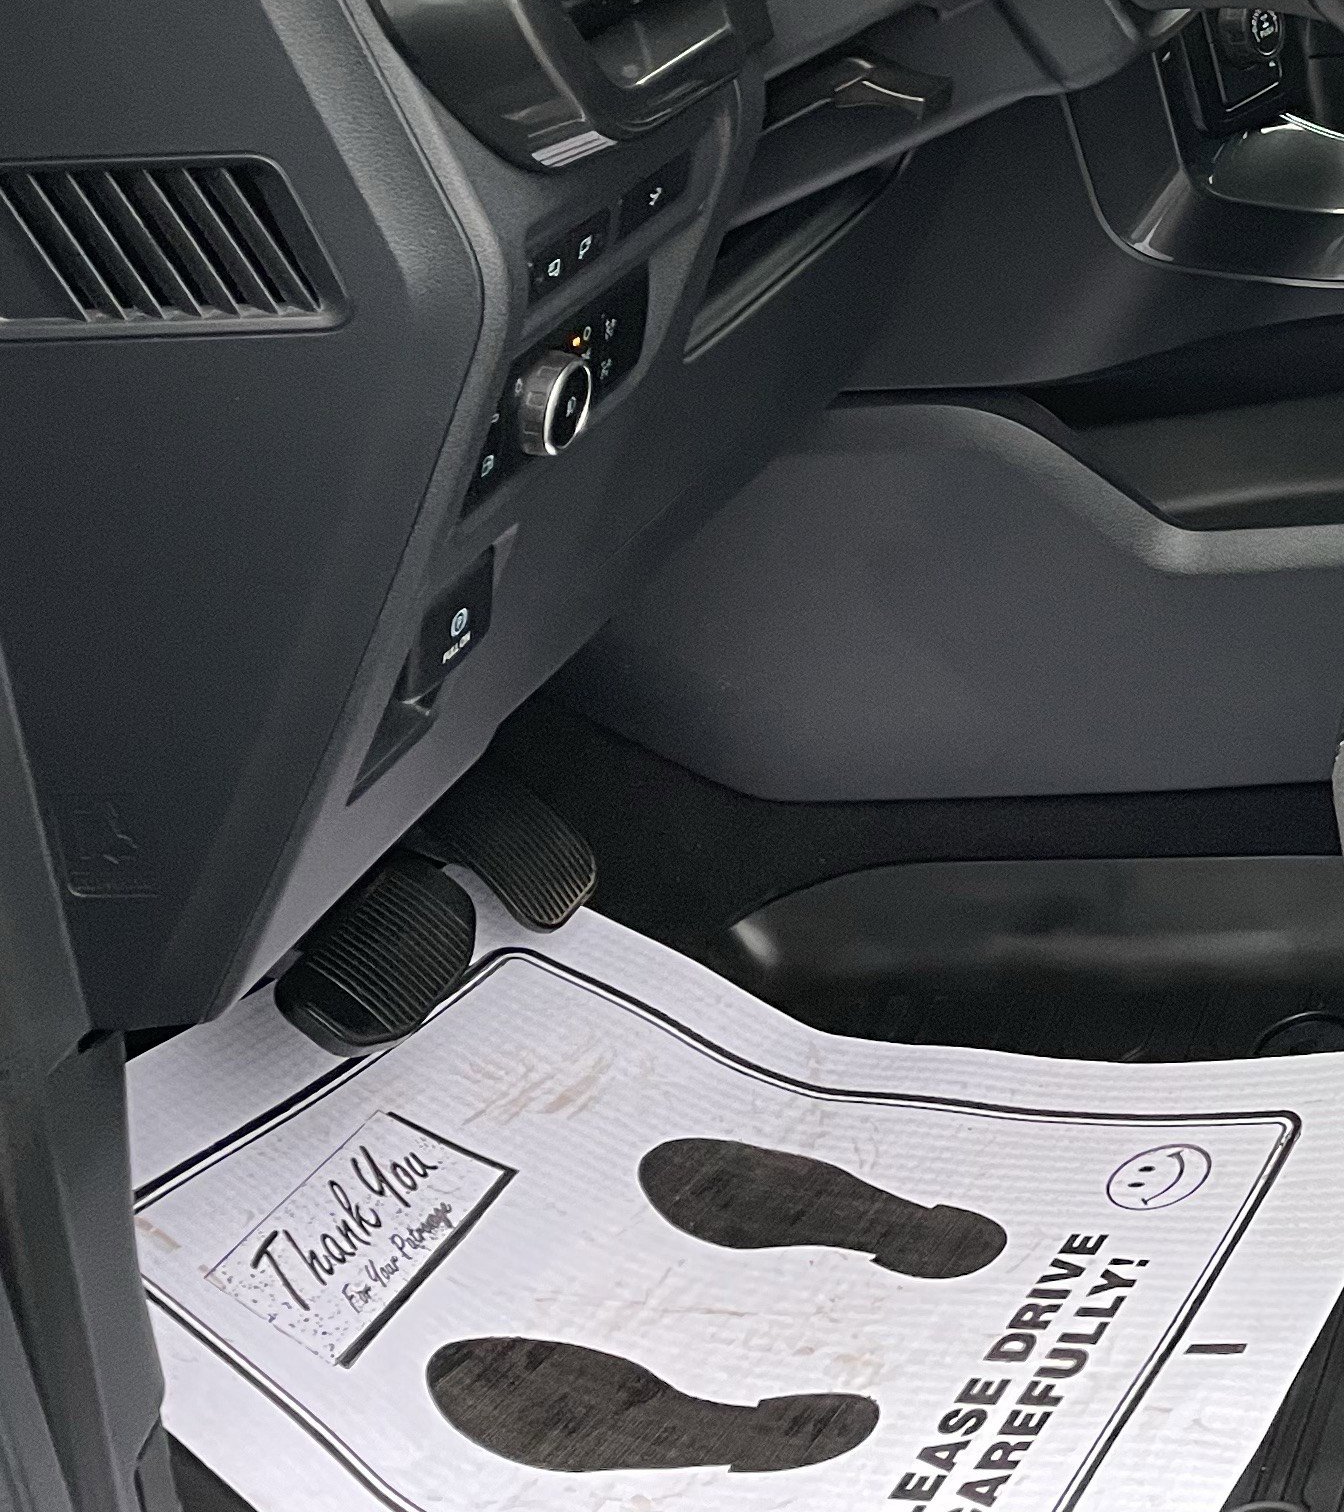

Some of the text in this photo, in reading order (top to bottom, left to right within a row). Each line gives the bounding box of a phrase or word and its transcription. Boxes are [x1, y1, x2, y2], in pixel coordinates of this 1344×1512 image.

[250, 1145, 438, 1311] Thank You
[341, 1282, 372, 1313] For
[888, 1233, 1109, 1512] EASE DRIVE
[947, 1258, 1150, 1512] AREFULLY!
